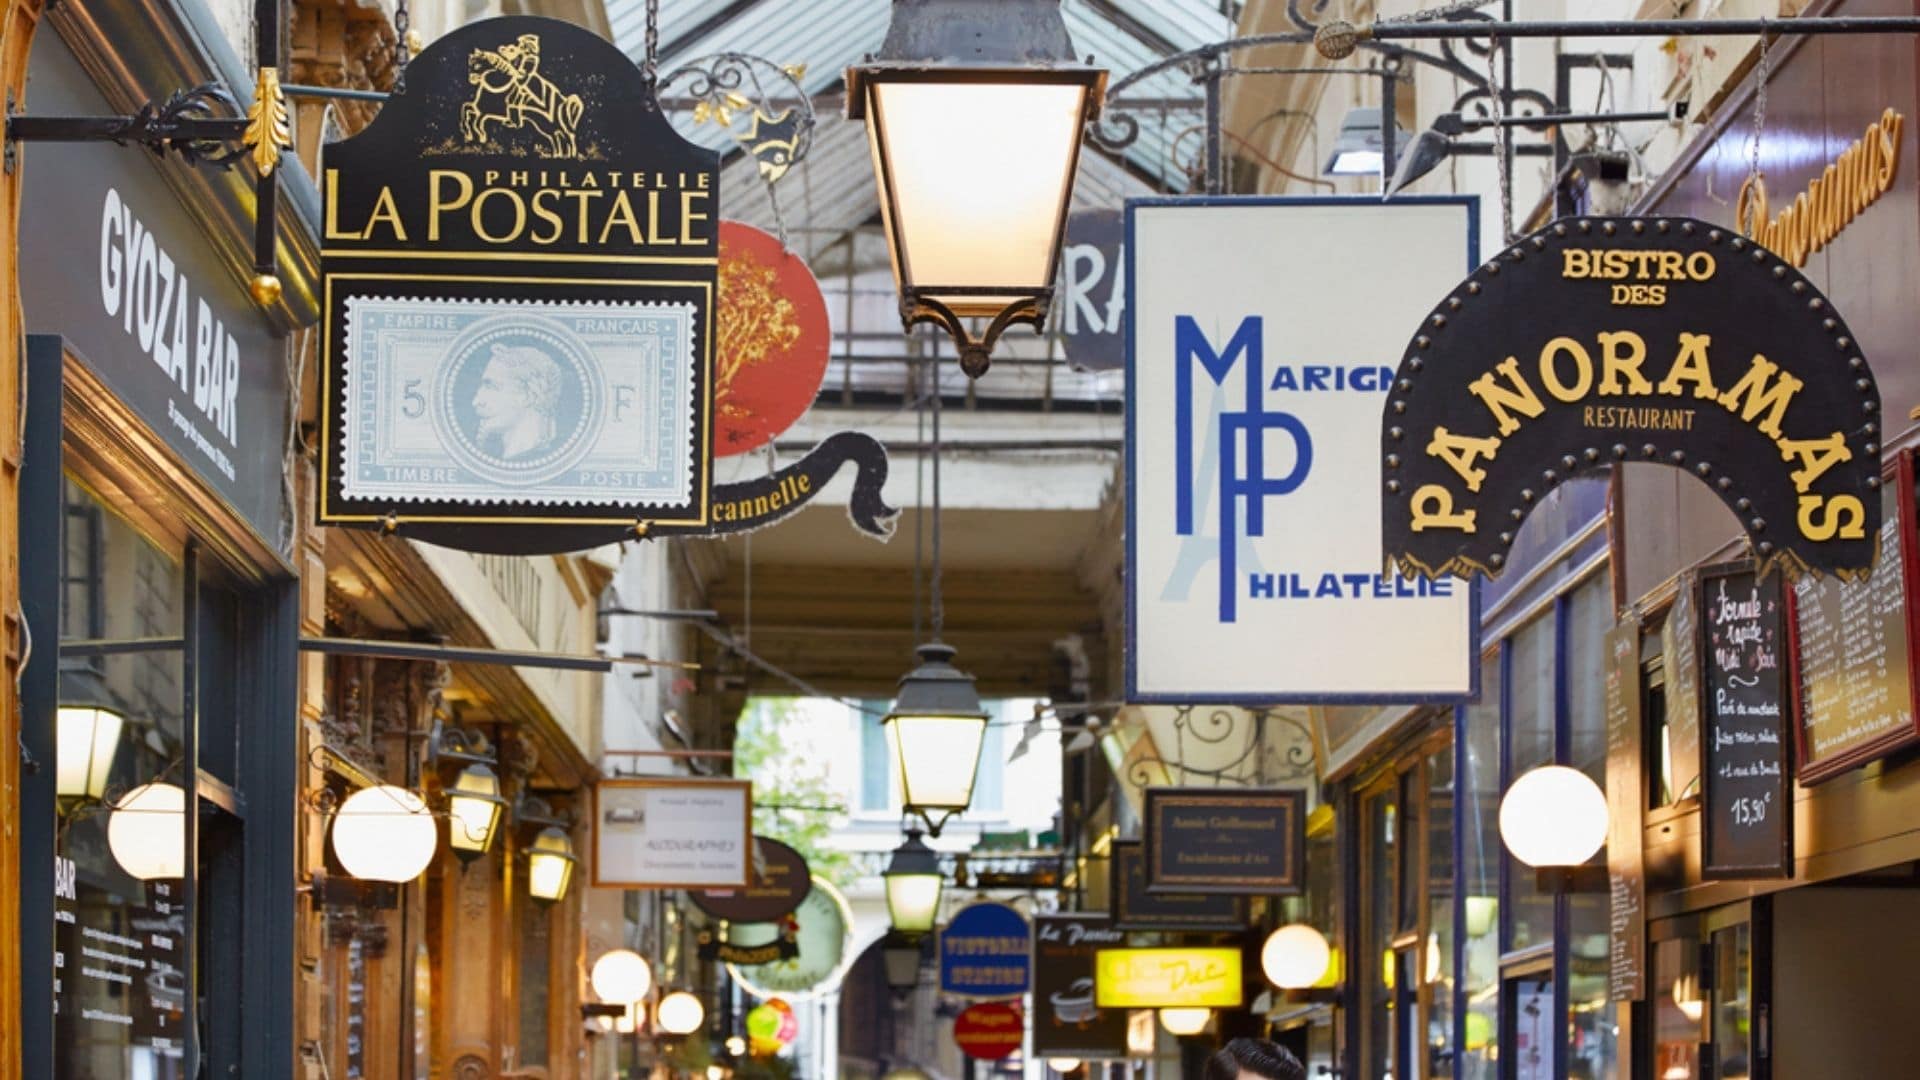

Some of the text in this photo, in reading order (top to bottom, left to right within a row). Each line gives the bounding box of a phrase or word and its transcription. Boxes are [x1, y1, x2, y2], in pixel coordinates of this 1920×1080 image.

[486, 171, 710, 189] PHILATELIE
[1736, 107, 1903, 268] Panoramas
[325, 168, 711, 246] LA POSTALE
[1562, 248, 1716, 281] BISTRO
[1611, 285, 1667, 306] DES
[101, 187, 188, 394] GYOZA
[194, 295, 240, 448] BAR
[384, 314, 660, 336] EMPIRE FRANÇAIS
[401, 379, 636, 424] 5 F
[1584, 405, 1696, 432] RESTAURANT
[1410, 330, 1867, 542] PANORAMAS
[384, 468, 649, 488] TIMBRE POSTE
[711, 474, 811, 522] cannelle
